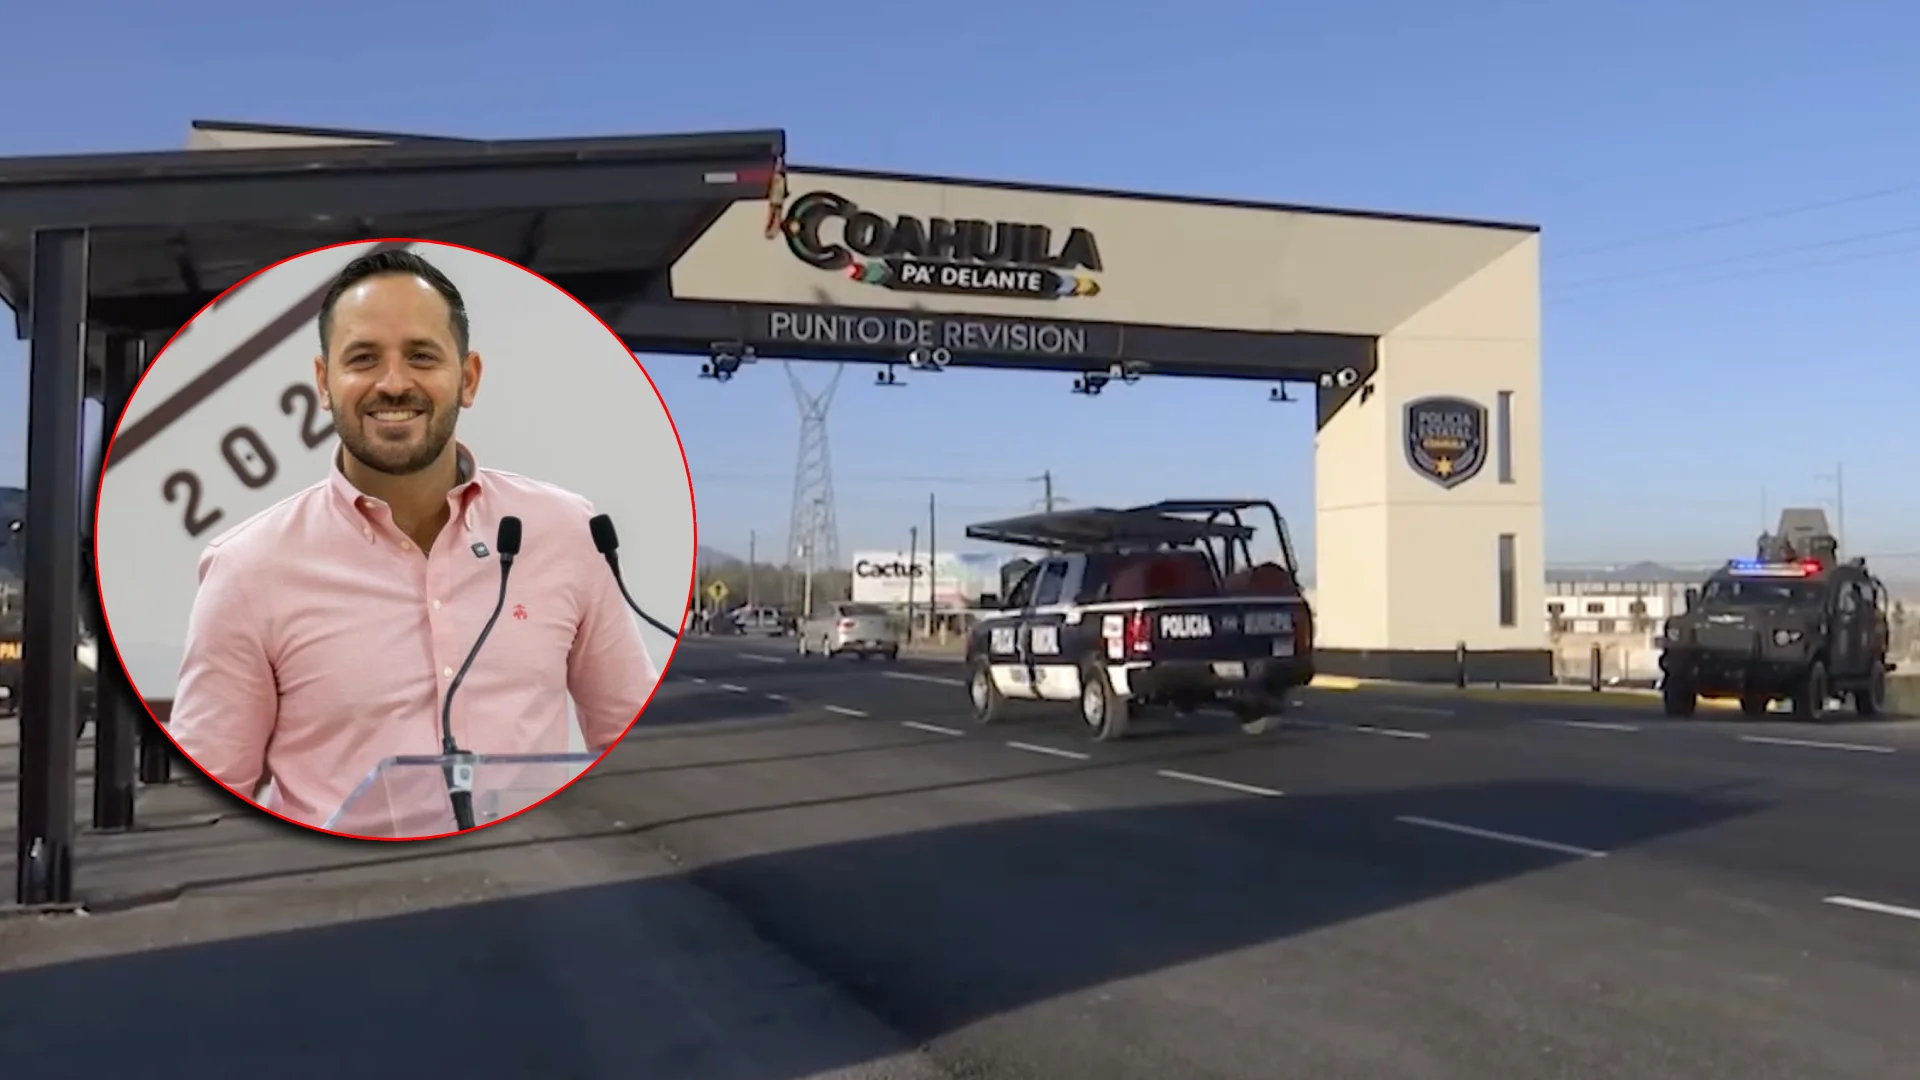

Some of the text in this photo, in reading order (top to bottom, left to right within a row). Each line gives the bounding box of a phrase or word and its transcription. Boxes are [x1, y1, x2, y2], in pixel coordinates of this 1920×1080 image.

[784, 190, 1103, 272] COAHUILA
[901, 264, 1043, 292] PA' DELANTE
[769, 311, 1087, 354] PUNTO DE REVISION
[856, 559, 923, 578] Cactus
[1160, 613, 1213, 639] POLICIA
